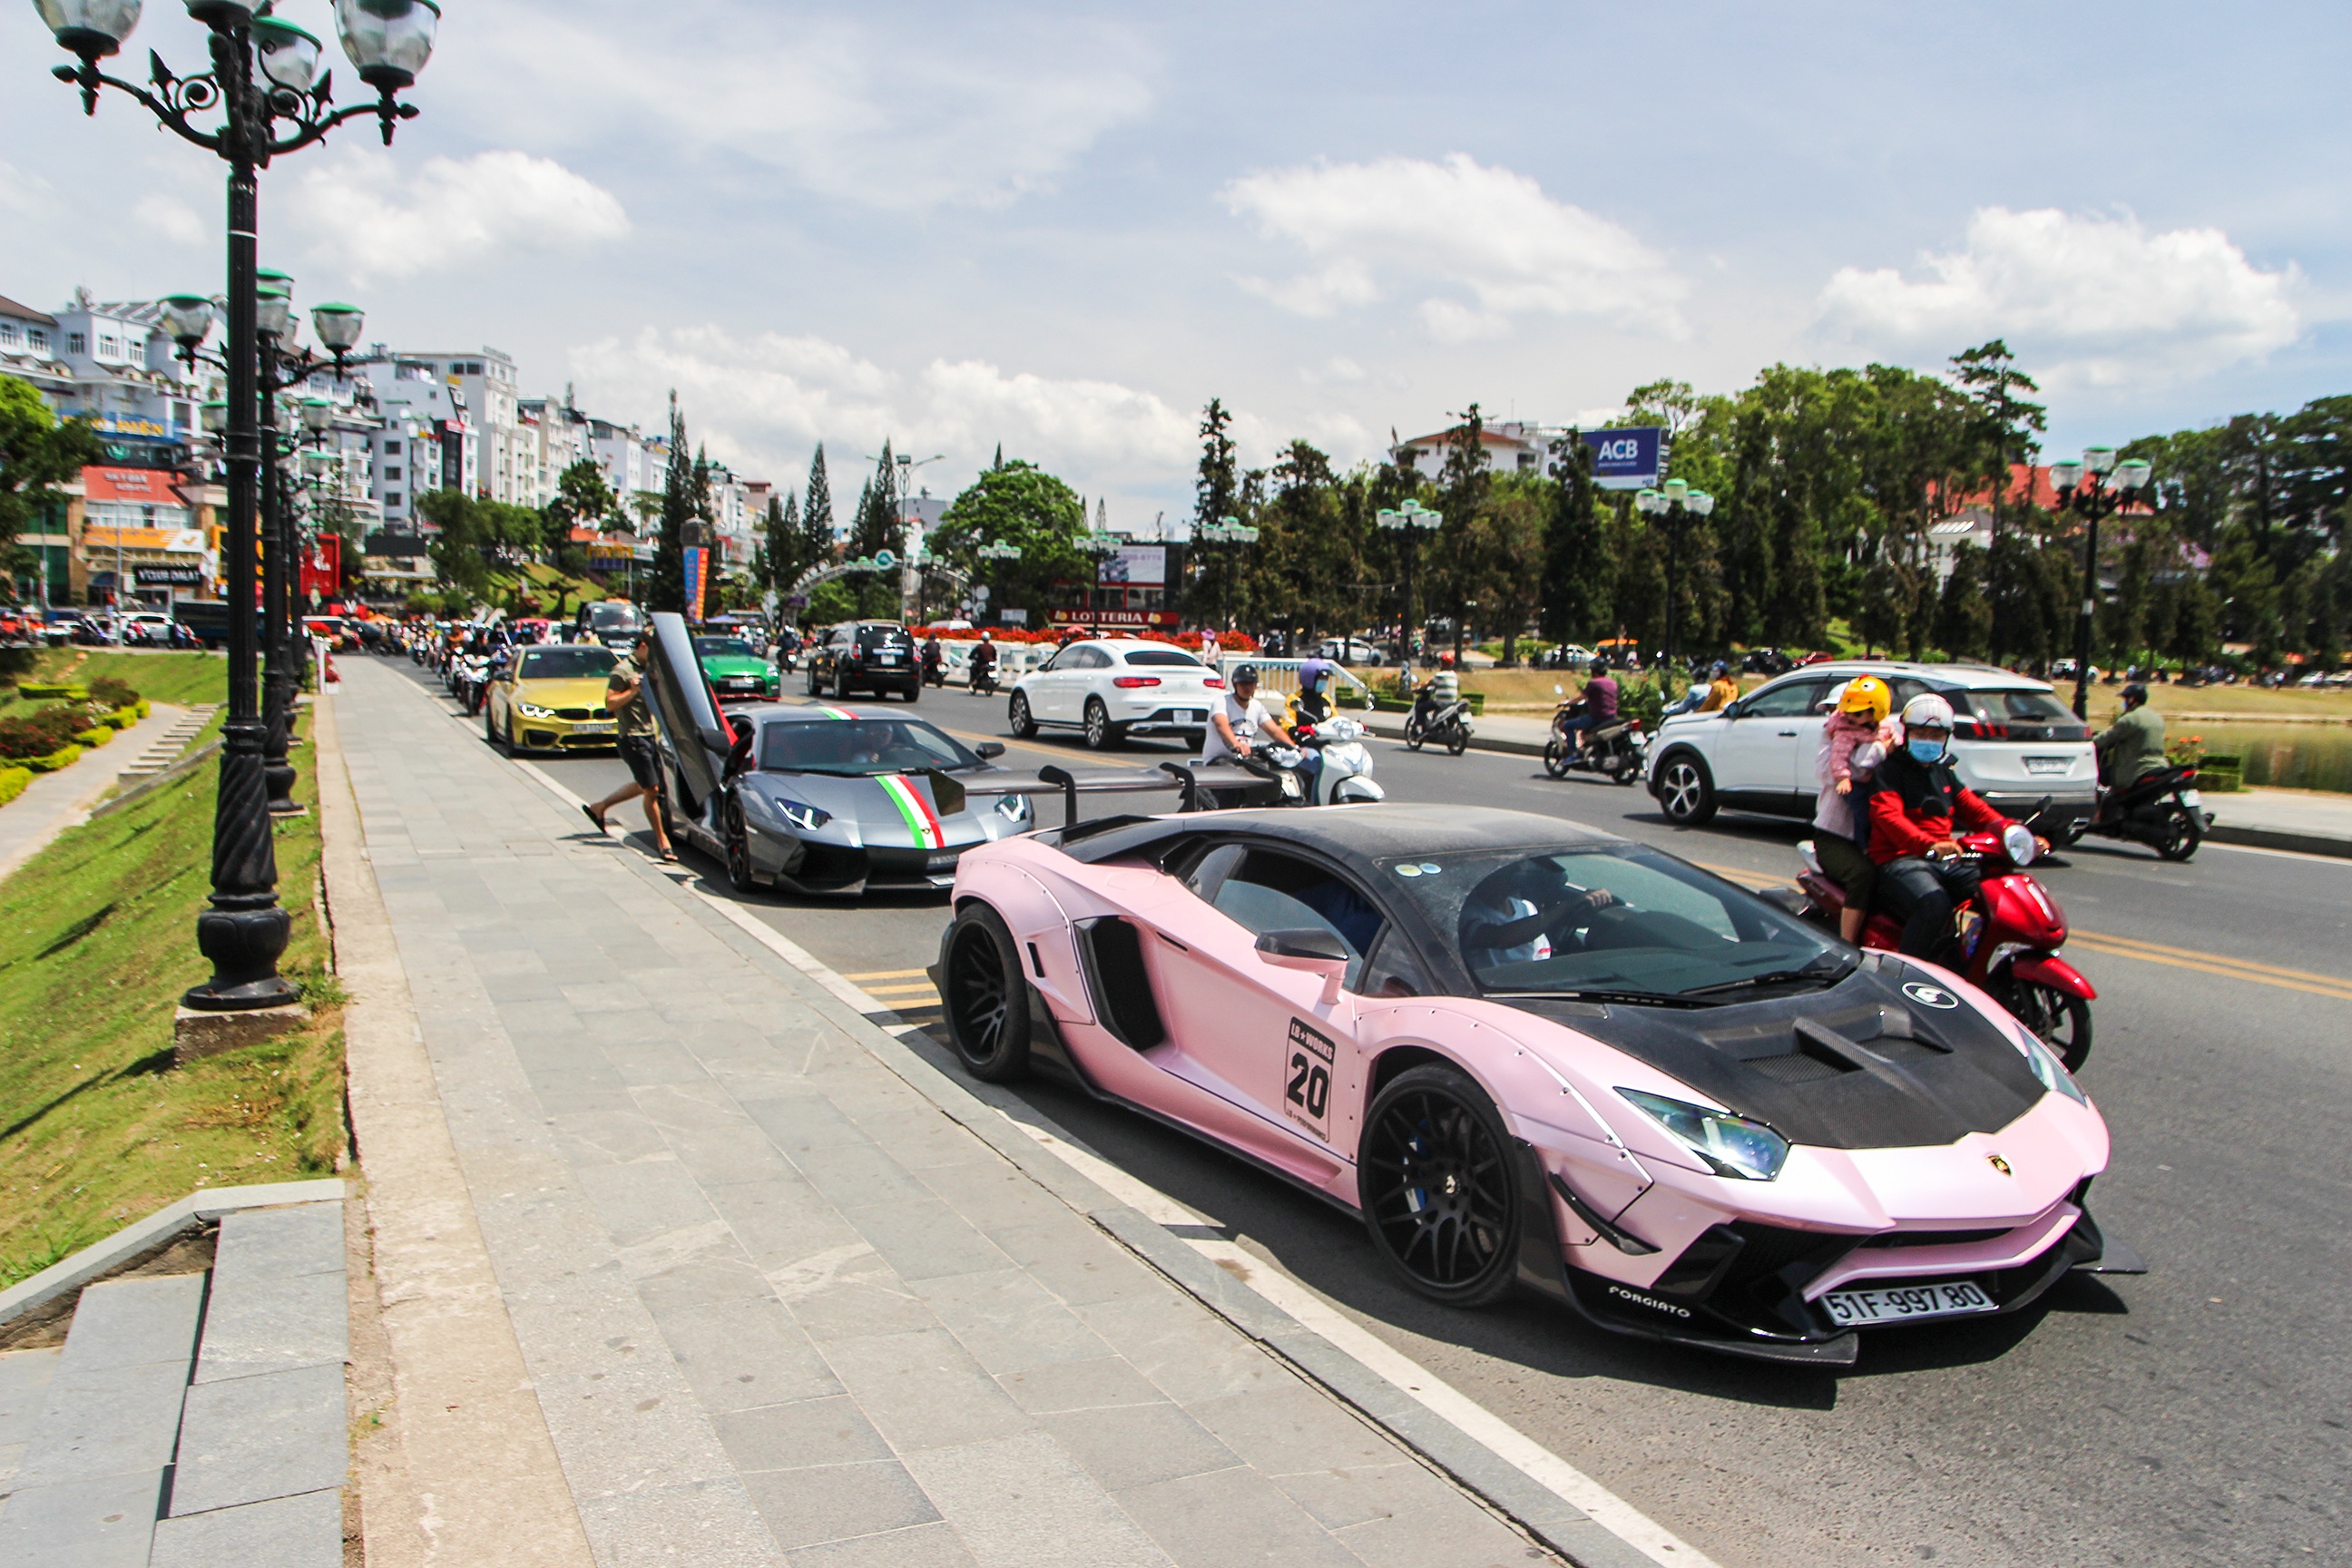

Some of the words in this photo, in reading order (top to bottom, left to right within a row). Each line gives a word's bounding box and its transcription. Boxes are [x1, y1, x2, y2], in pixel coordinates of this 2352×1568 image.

[1599, 439, 1639, 461] ACB
[1287, 1052, 1329, 1121] 20
[1608, 1285, 1691, 1318] FORGIATO
[1825, 1284, 1986, 1319] 51F-997.80
